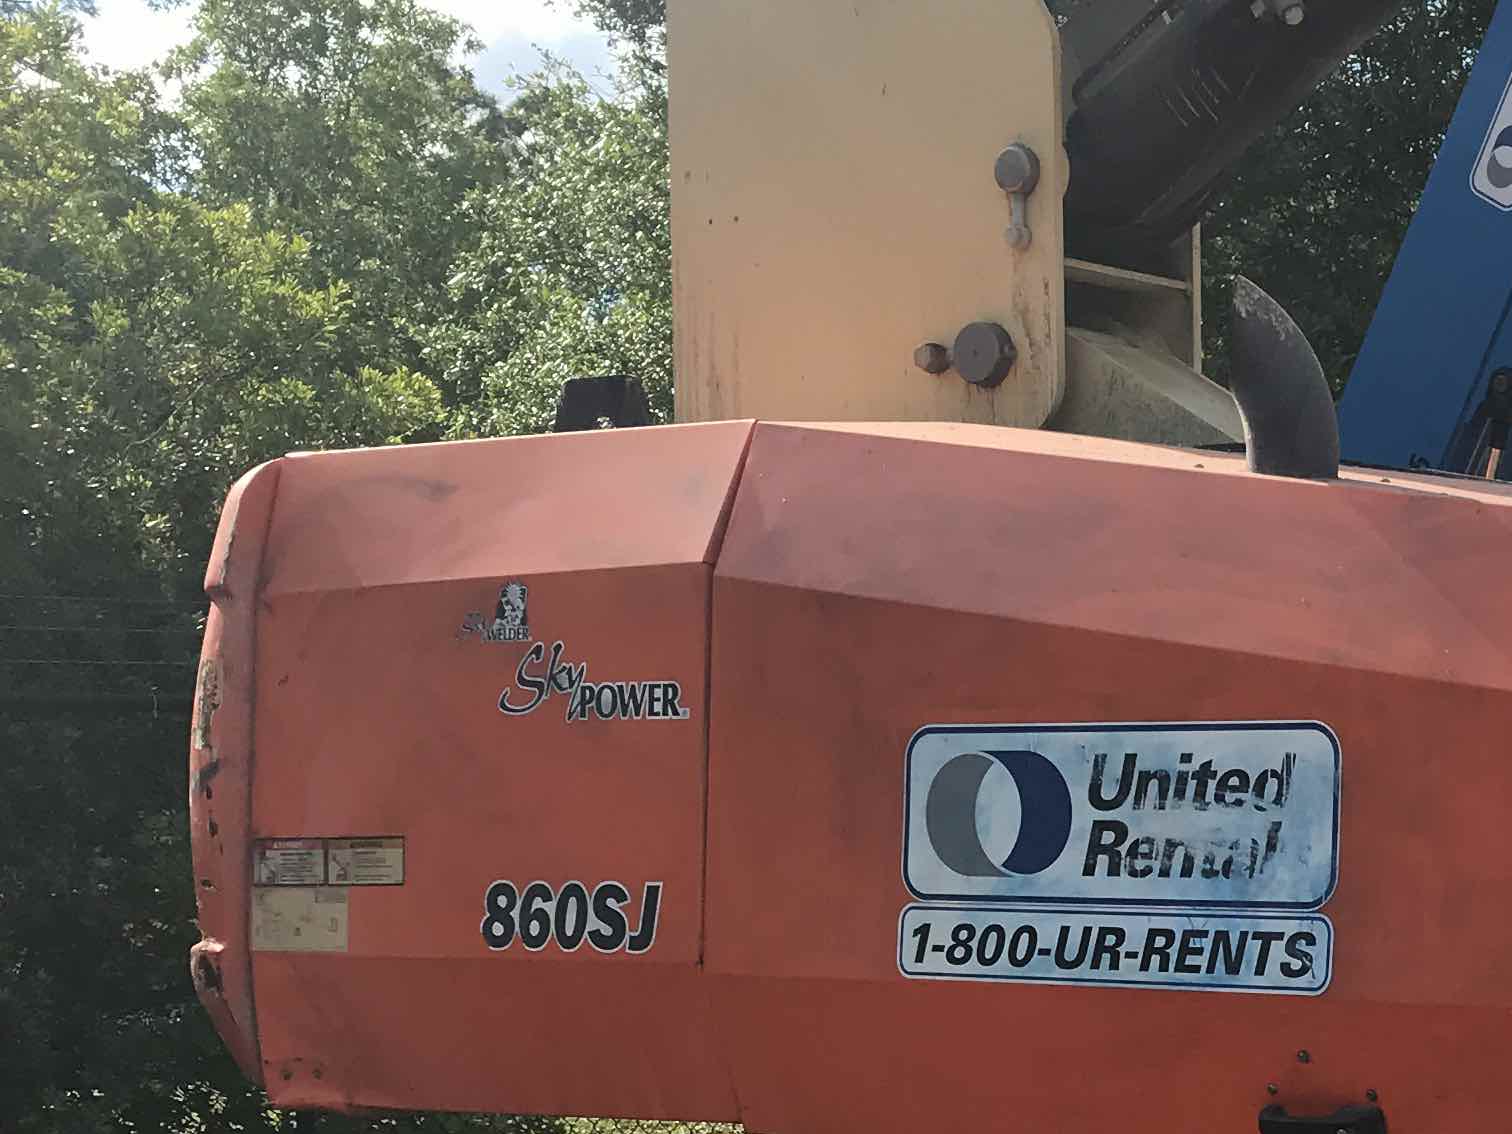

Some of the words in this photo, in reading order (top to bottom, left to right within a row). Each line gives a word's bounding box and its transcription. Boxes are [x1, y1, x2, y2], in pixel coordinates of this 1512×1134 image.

[577, 682, 682, 718] POWER
[1087, 751, 1297, 812] United
[483, 884, 662, 951] 860SJ
[911, 922, 1317, 978] 1-800-UR-RENTS
